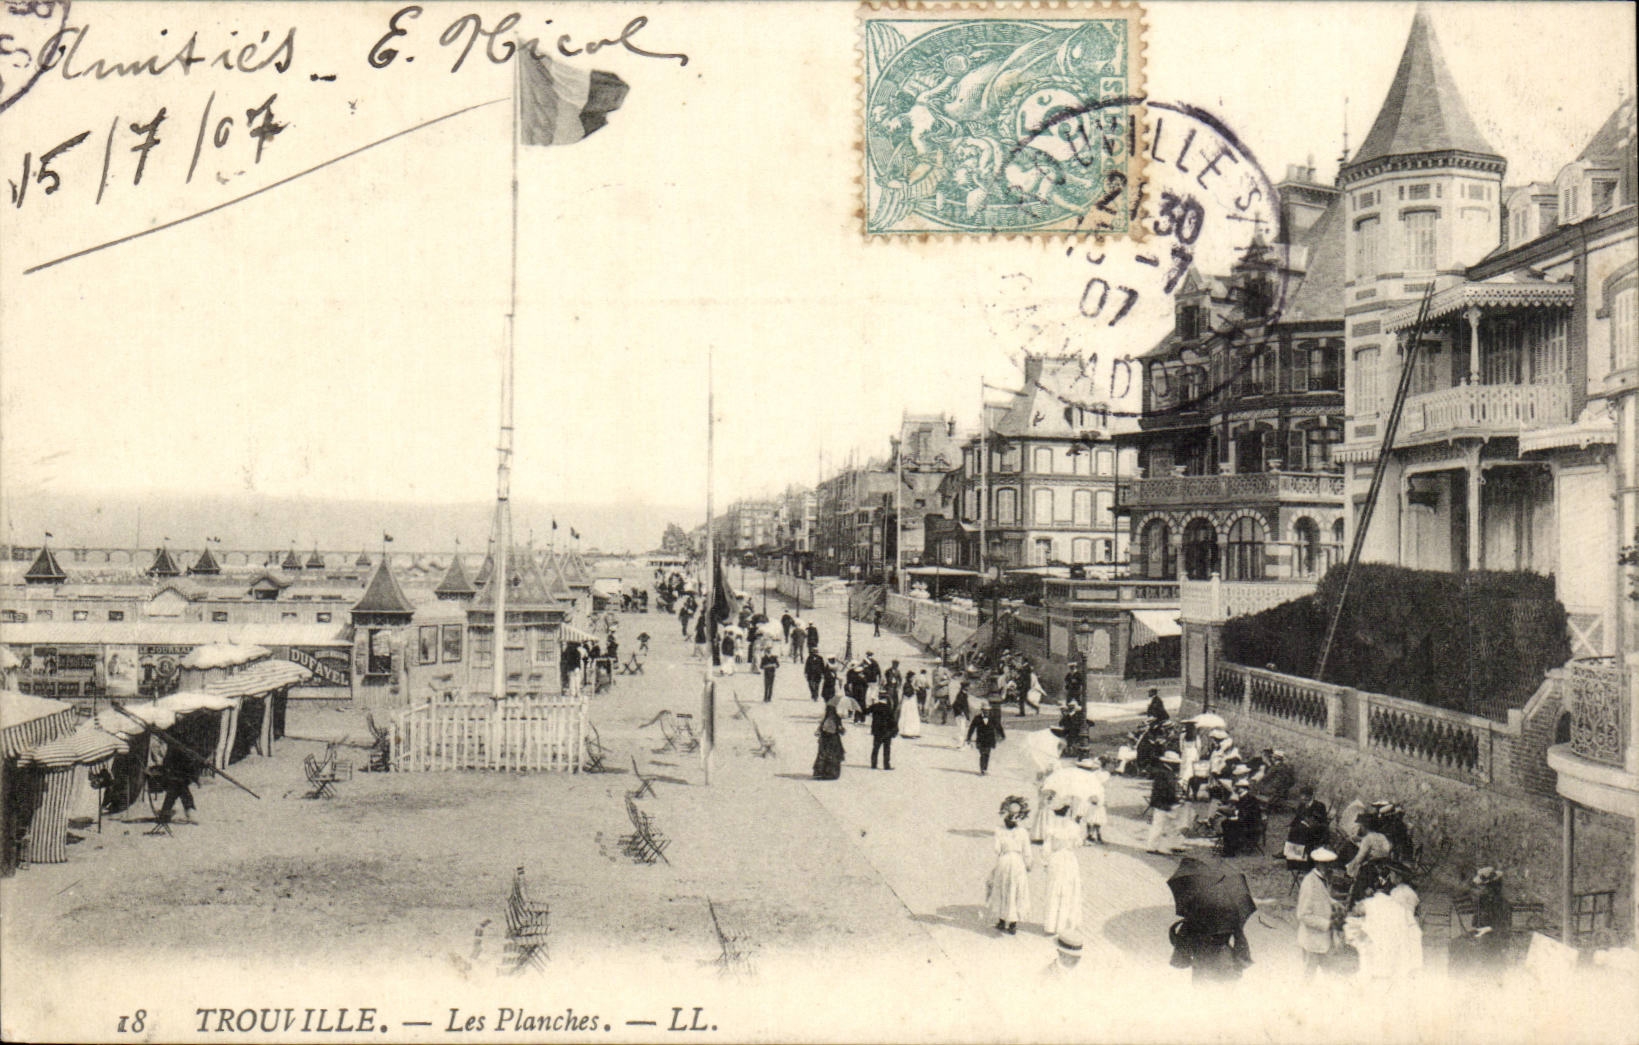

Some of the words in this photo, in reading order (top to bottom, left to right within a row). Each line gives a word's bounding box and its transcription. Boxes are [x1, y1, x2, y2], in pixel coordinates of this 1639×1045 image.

[366, 6, 424, 69] E.
[1080, 276, 1139, 327] 07
[291, 648, 350, 686] DUFAYEL
